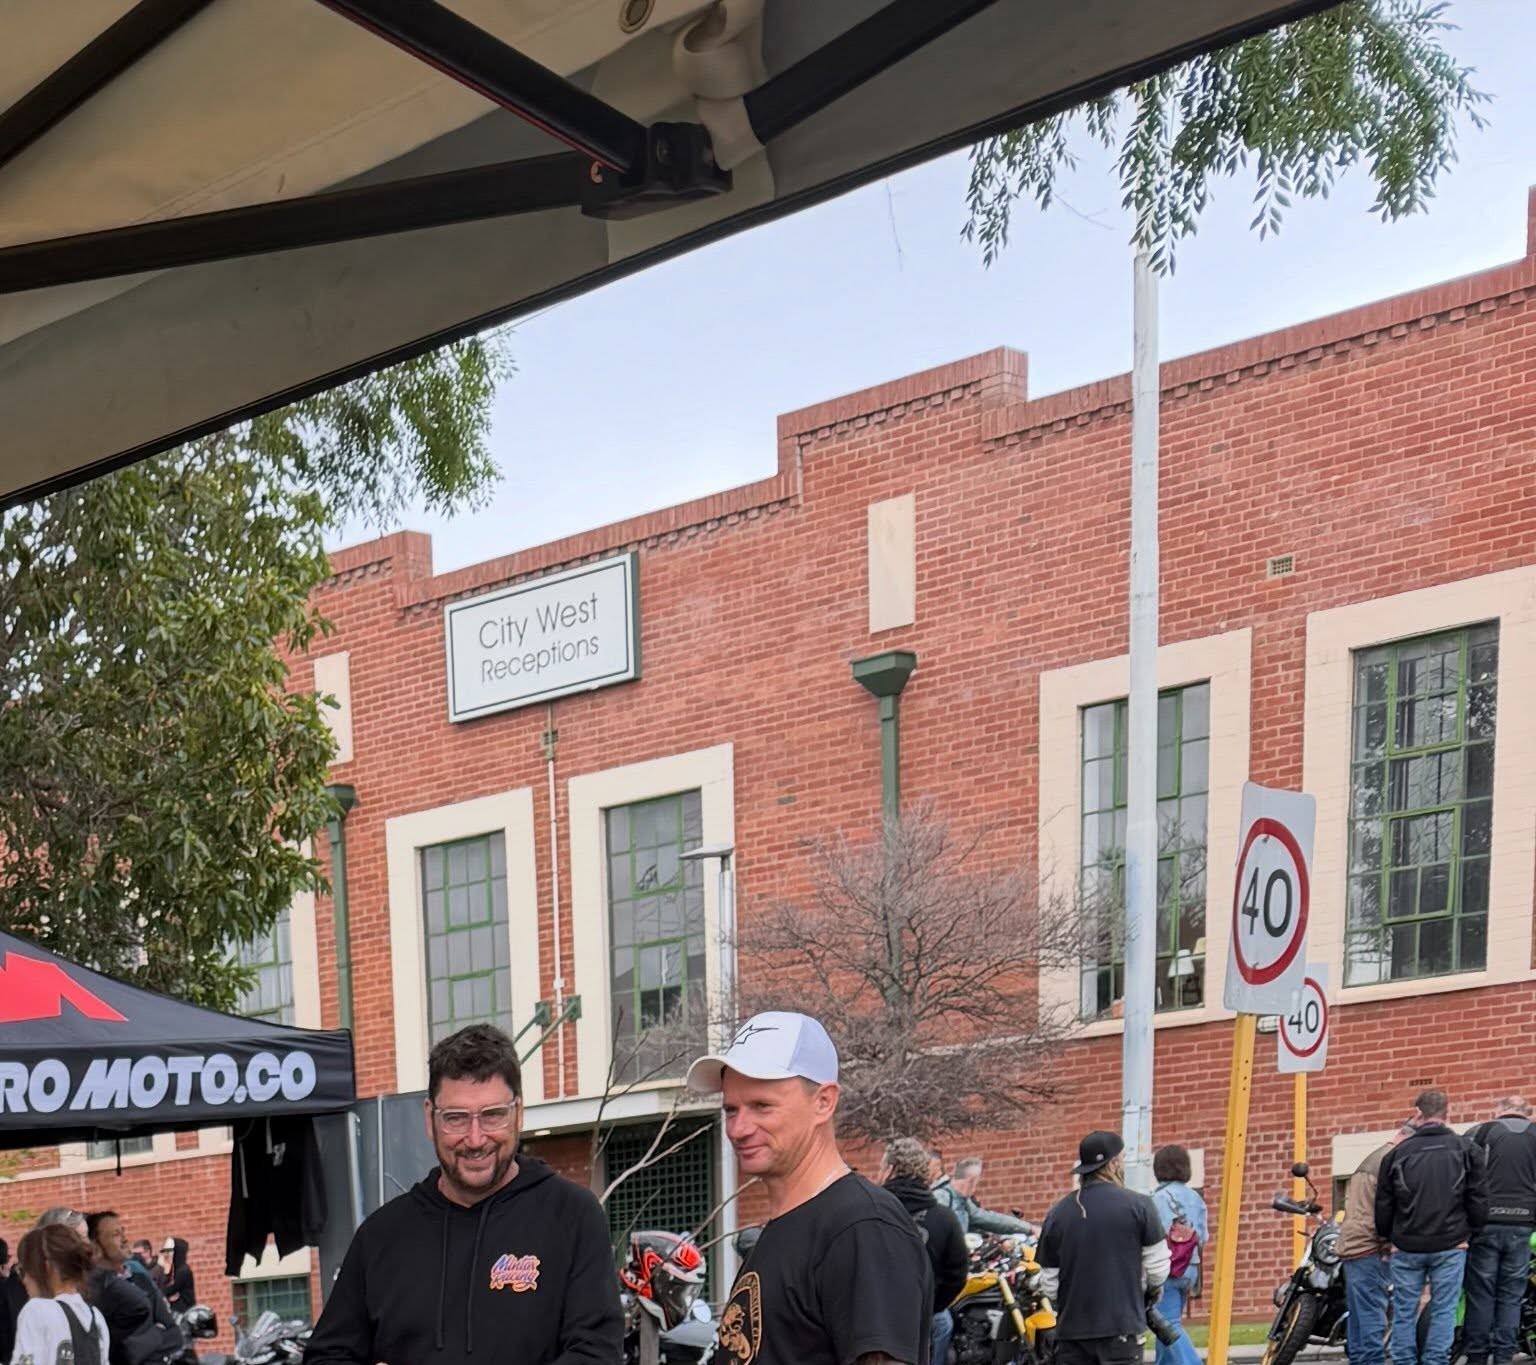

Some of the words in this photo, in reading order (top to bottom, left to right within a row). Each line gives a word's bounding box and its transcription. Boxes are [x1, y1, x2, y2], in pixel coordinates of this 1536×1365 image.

[479, 616, 528, 648] City
[536, 592, 598, 634] West
[481, 634, 599, 685] Receptions
[1241, 866, 1293, 938] 40
[1288, 1000, 1320, 1035] 40
